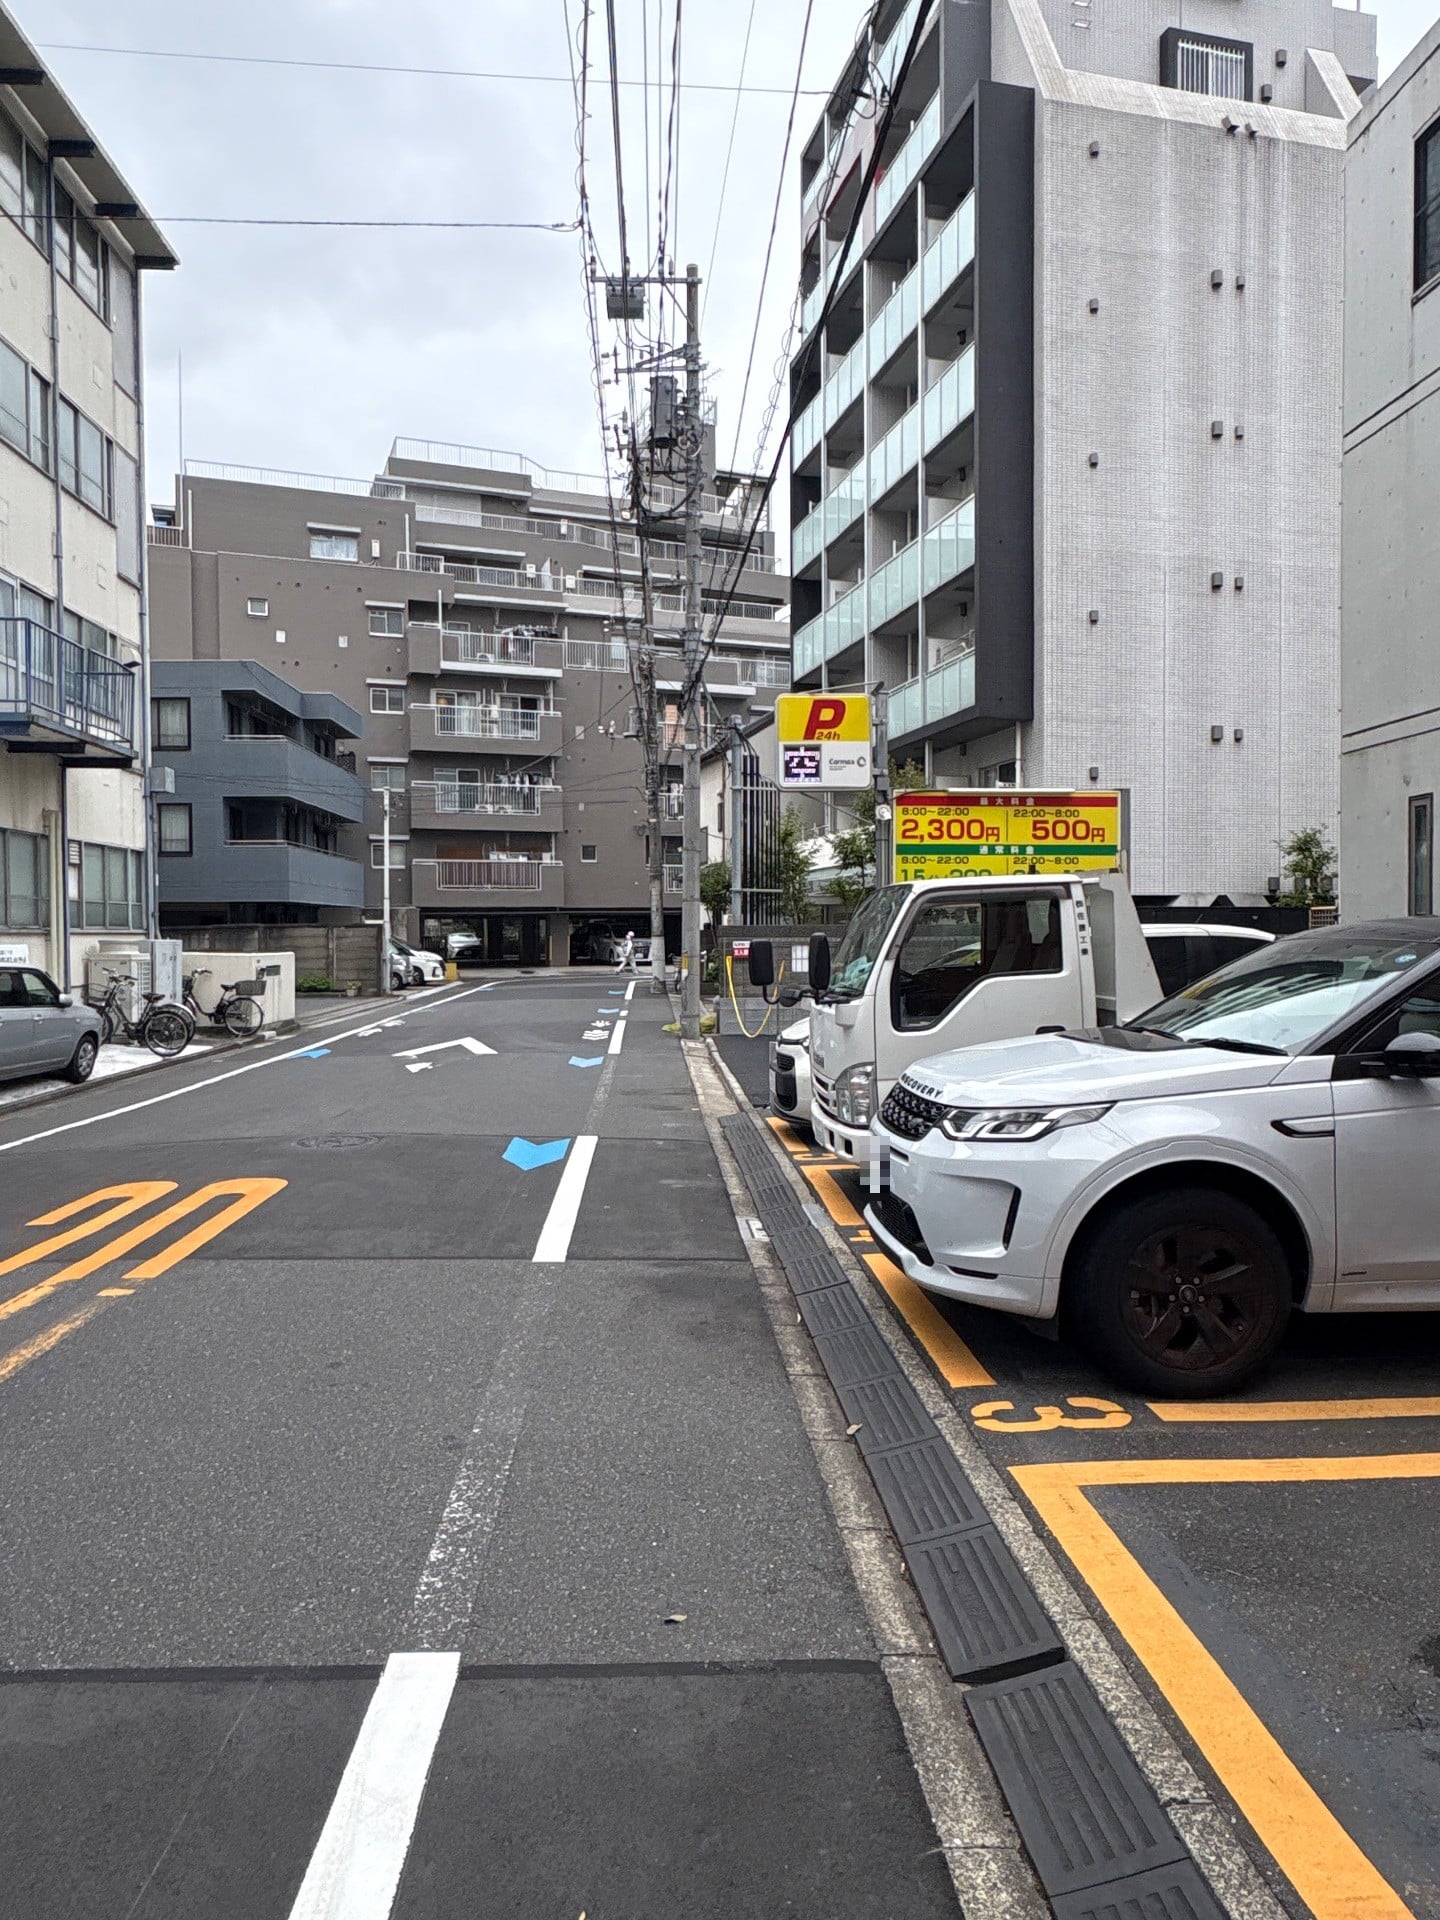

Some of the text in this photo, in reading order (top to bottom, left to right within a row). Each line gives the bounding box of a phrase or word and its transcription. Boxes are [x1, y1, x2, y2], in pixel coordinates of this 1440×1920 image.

[803, 699, 846, 740] P
[816, 731, 841, 741] 24h
[901, 818, 1000, 843] 2,300円
[1031, 819, 1106, 843] 500円
